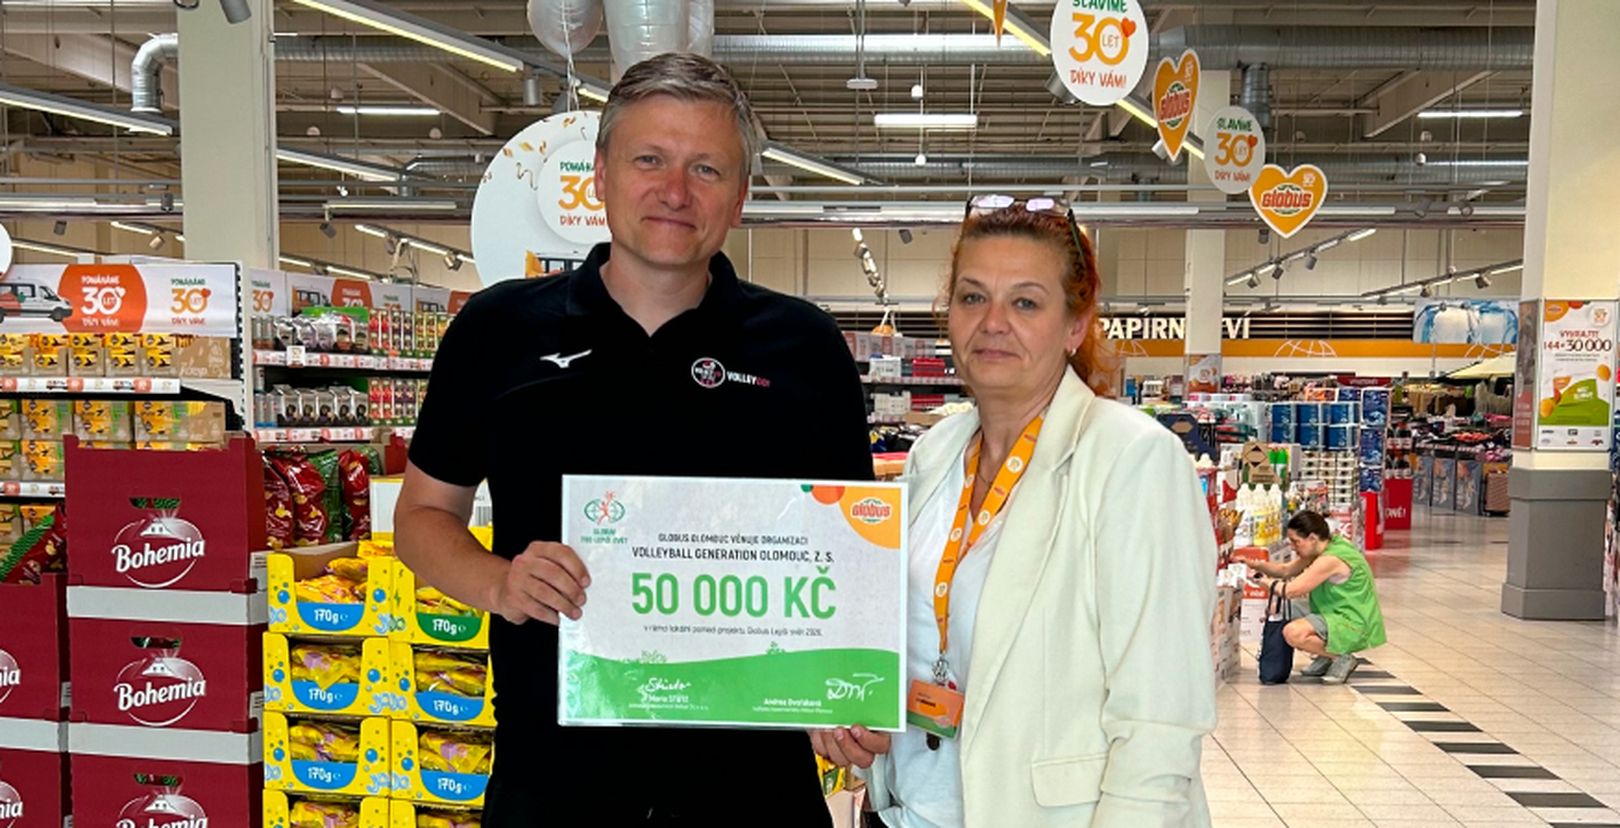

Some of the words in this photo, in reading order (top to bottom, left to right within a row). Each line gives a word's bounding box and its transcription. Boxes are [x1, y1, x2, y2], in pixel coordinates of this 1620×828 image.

[1068, 12, 1130, 66] 30
[1102, 33, 1120, 48] LET
[1070, 67, 1096, 86] DÍKY
[1215, 133, 1254, 168] 30
[81, 286, 123, 315] 30
[170, 287, 208, 314] 30
[658, 533, 689, 543] GLOBUS
[691, 533, 729, 544] OLOMOUC
[731, 533, 759, 546] VĚNUJE
[761, 535, 808, 546] ORGANIZACI
[111, 536, 206, 574] Bohemia
[632, 547, 692, 559] VOLLEYBALL
[695, 548, 757, 561] GENERATION
[759, 550, 812, 563] OLOMOUC,
[632, 572, 679, 615] 50
[693, 573, 768, 618] 000
[783, 565, 837, 620] KČ
[313, 607, 340, 624] 170g
[433, 619, 459, 635] 170g
[113, 676, 207, 711] Bohemia
[433, 699, 459, 715] 170g
[307, 766, 333, 782] 170g
[436, 778, 463, 794] 170g
